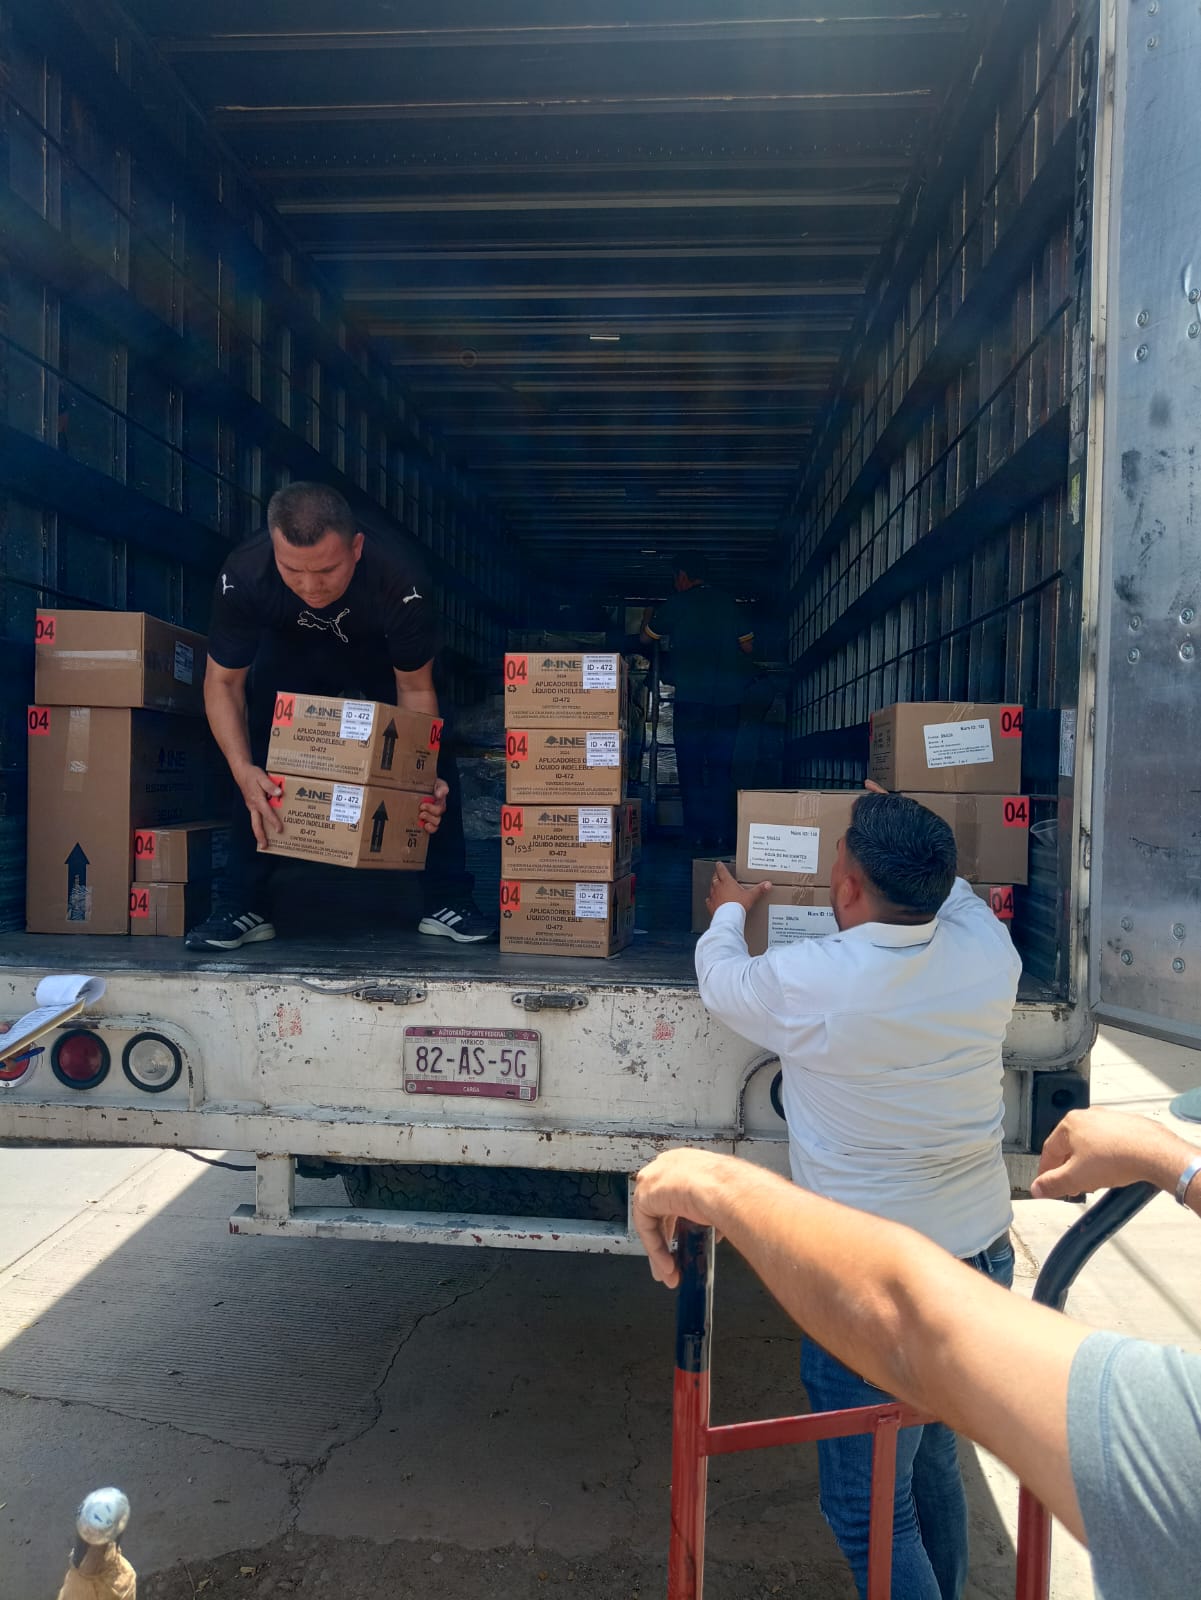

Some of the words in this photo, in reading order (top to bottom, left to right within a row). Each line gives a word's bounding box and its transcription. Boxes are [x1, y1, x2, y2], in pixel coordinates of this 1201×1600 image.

[36, 619, 55, 639] 04
[507, 660, 527, 680] 04
[556, 660, 582, 669] INE
[275, 700, 294, 720] 04
[318, 707, 342, 718] INE
[29, 711, 49, 729] 04
[1002, 712, 1022, 731] 04
[297, 728, 335, 737] APLICADORES
[430, 725, 441, 744] 04
[560, 737, 585, 745] INE
[507, 736, 527, 756] 04
[308, 790, 332, 801] INE
[288, 810, 325, 820] APLICADORES
[503, 812, 522, 831] 04
[552, 814, 578, 822] INE
[1005, 802, 1027, 822] 04
[284, 817, 305, 826] LÍQUIDO
[306, 820, 336, 830] INDELEBLE
[135, 835, 154, 853] 04
[501, 886, 519, 906] 04
[550, 888, 574, 897] INE
[130, 893, 149, 912] 04
[993, 893, 1014, 913] 04
[416, 1046, 527, 1078] 82-AS-5G
